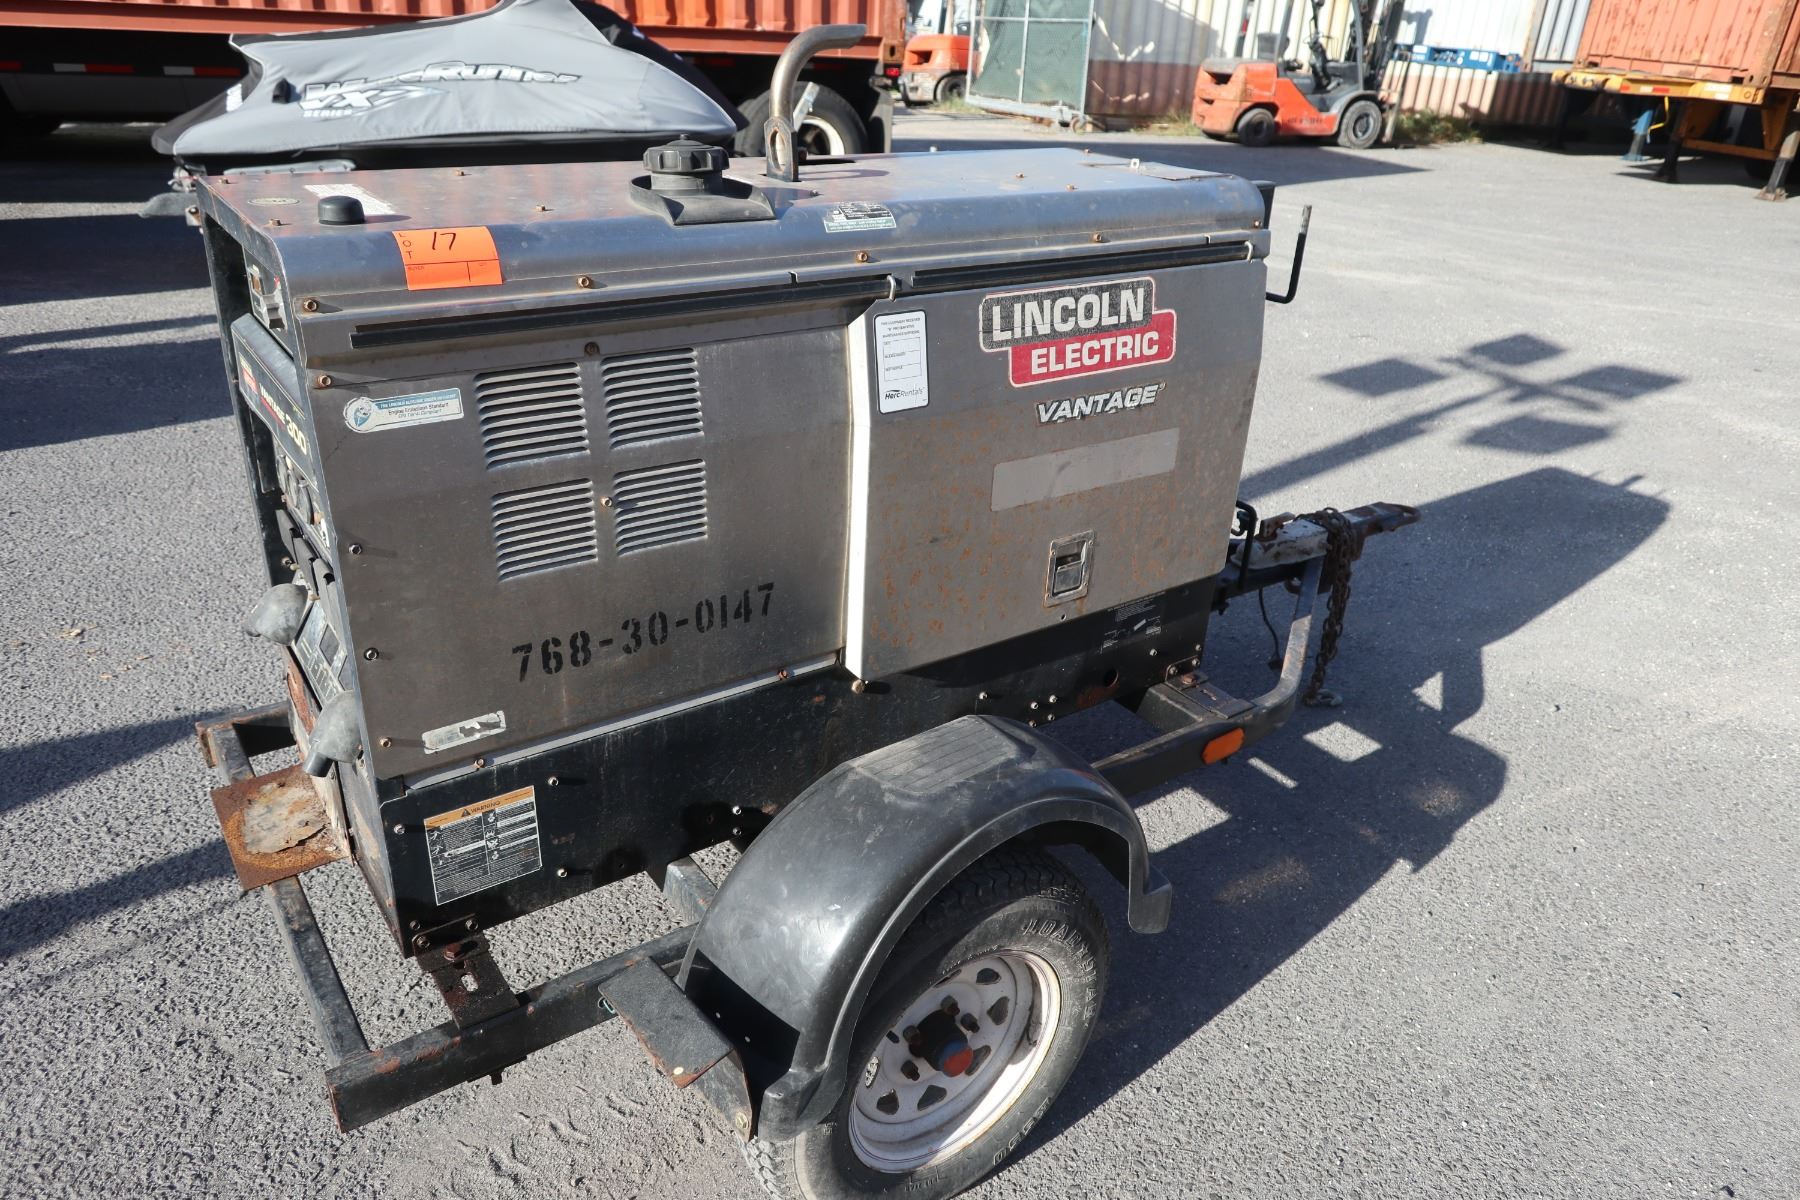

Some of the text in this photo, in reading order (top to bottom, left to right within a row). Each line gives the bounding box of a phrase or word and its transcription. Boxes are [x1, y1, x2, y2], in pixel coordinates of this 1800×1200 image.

[399, 232, 413, 260] LOT
[431, 231, 457, 251] 17
[992, 287, 1145, 342] LINCOLN
[1031, 330, 1159, 375] ELECTRIC
[885, 388, 922, 400] HercRentals
[1036, 383, 1160, 424] VANTAGE
[285, 413, 308, 456] 300
[512, 582, 775, 682] 768-30-0147
[470, 801, 501, 813] WARNING
